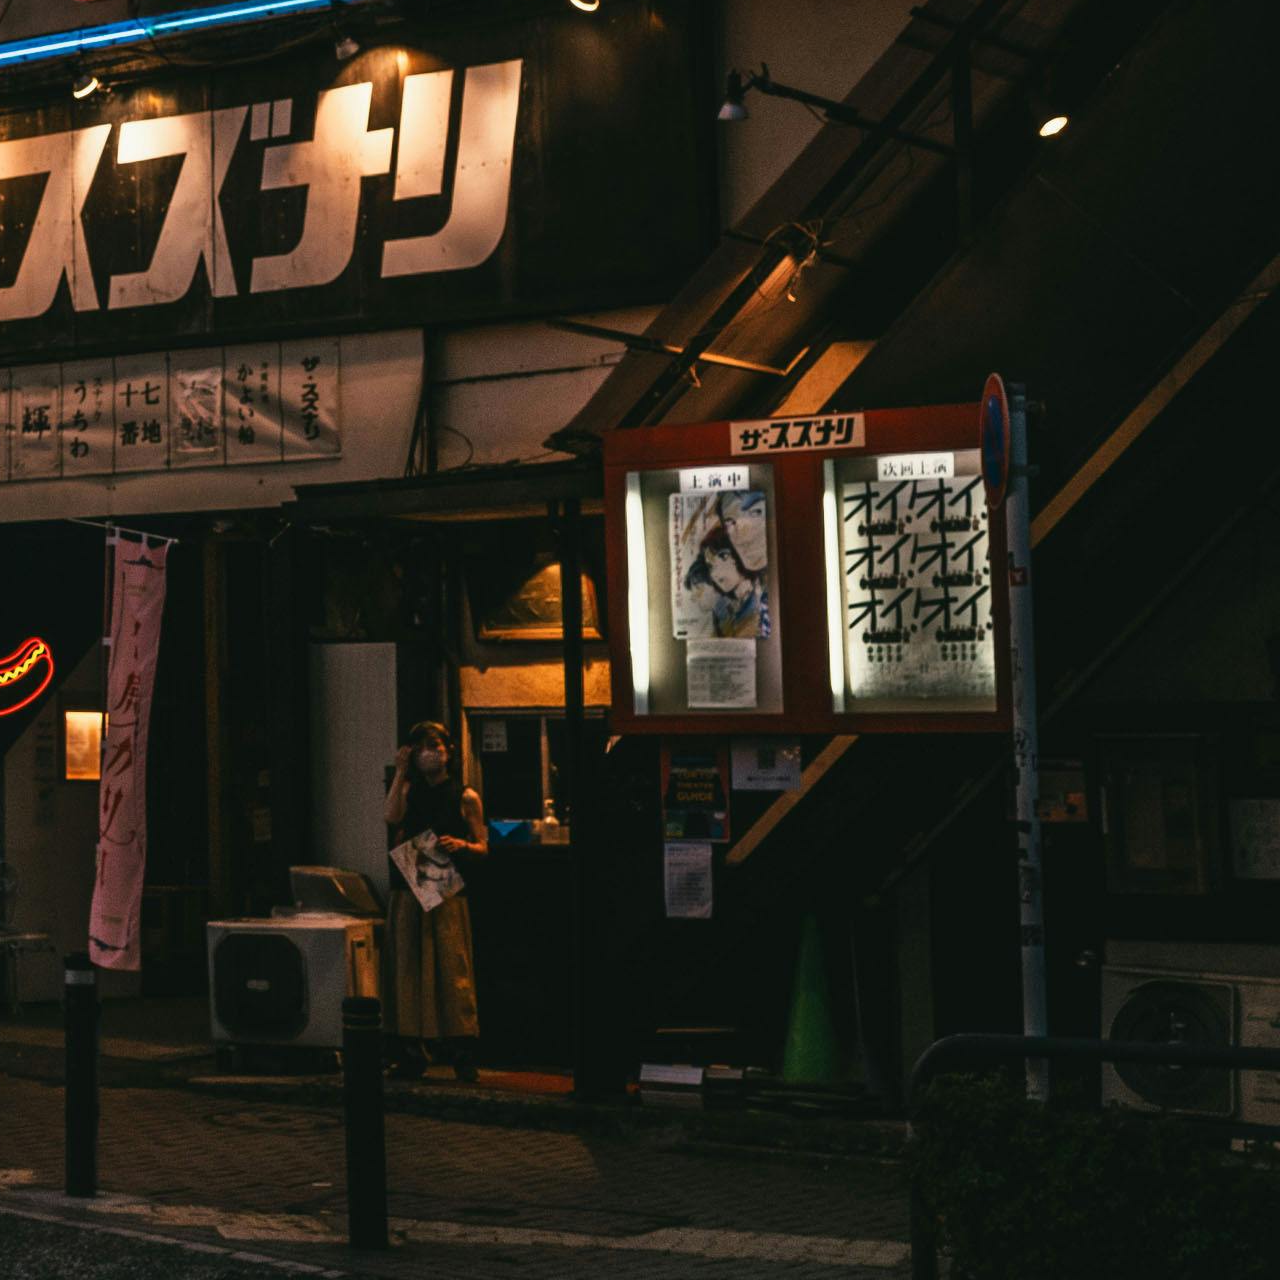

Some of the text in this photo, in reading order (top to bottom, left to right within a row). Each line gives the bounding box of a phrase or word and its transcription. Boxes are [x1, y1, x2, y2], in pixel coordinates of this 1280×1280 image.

[70, 379, 90, 458] うちわ
[739, 417, 856, 451] ザ・スズナリ
[688, 471, 742, 490] 上演中
[882, 459, 948, 477] 次回上演
